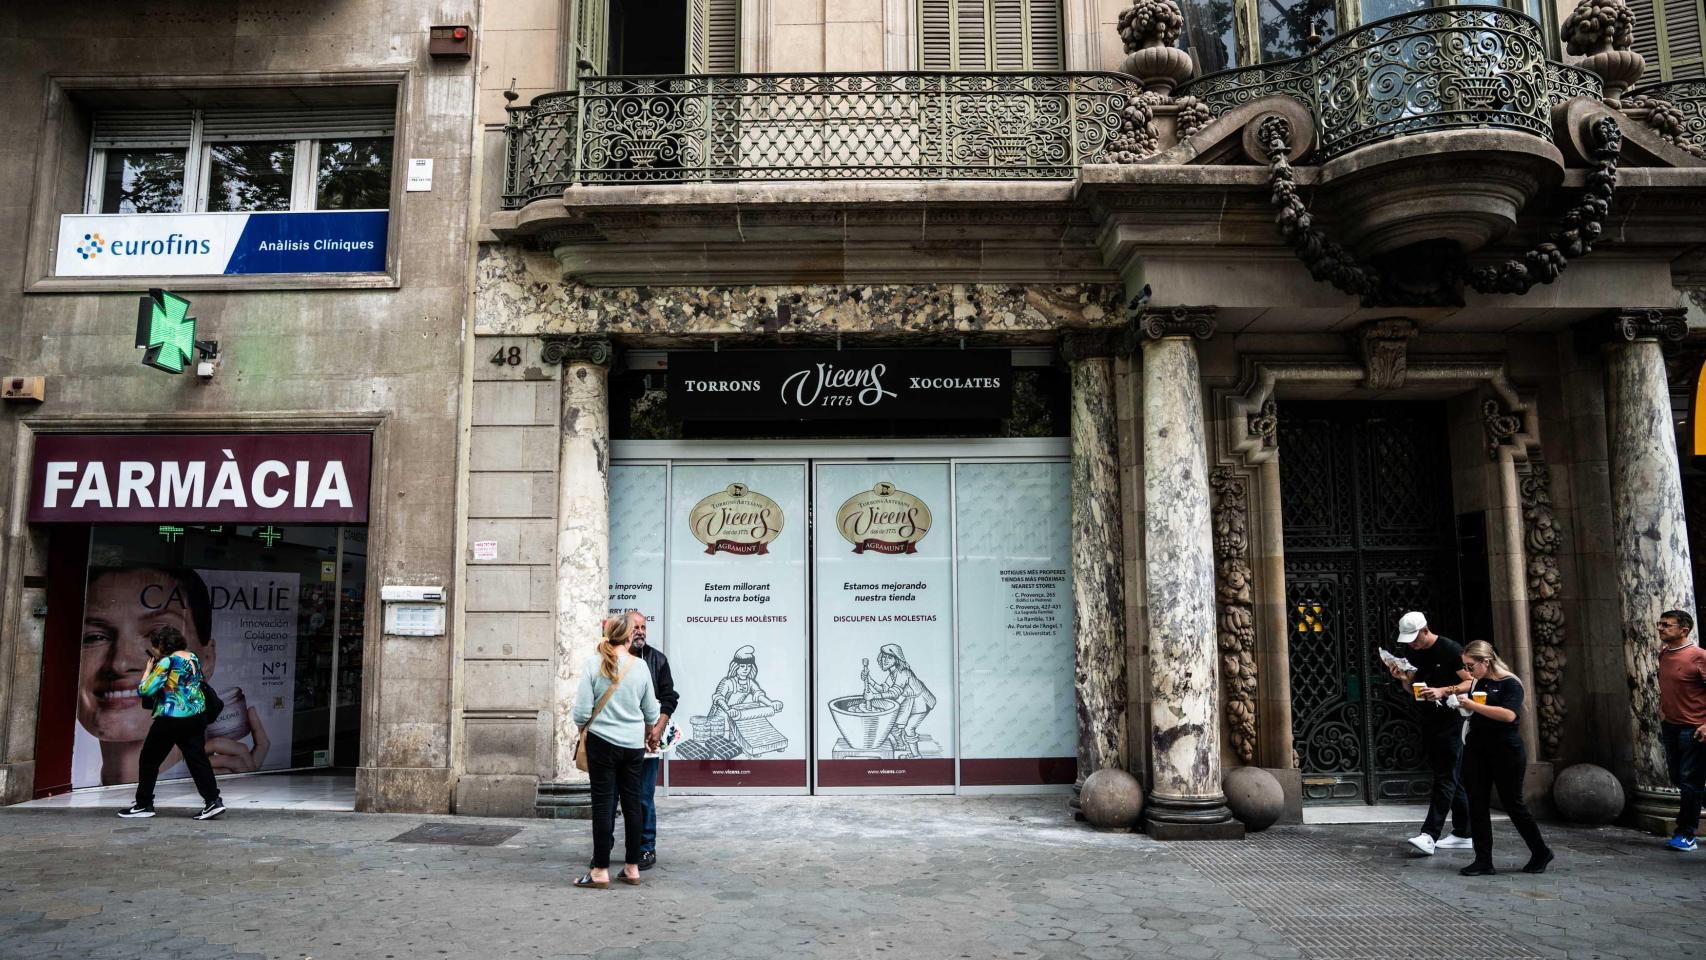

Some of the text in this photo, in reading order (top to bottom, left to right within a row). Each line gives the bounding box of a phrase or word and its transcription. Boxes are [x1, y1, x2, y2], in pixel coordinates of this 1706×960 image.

[111, 233, 210, 256] eurofins
[259, 237, 375, 252] Anàlisis Clíniques
[490, 346, 522, 367] 48
[685, 363, 1001, 406] TORRONS Vicens XOCOLATES
[821, 395, 853, 406] 1775
[43, 449, 353, 508] FARMÀCIA
[695, 507, 779, 539] Vicens
[843, 506, 927, 538] Vicens
[717, 543, 757, 553] AGRAMUNT
[865, 542, 905, 552] AGRAMUNT
[615, 582, 653, 591] improving
[704, 582, 770, 591] Estem millorant
[843, 581, 927, 592] Estamos mejorando
[704, 593, 770, 604] la nostra botiga
[854, 593, 916, 602] nuestra tienda
[240, 617, 289, 628] Innovación
[745, 614, 788, 623] MOLÈSTIES
[833, 615, 876, 623] DISCULPEN
[894, 614, 937, 622] MOLESTIAS
[244, 630, 288, 641] Colágeno
